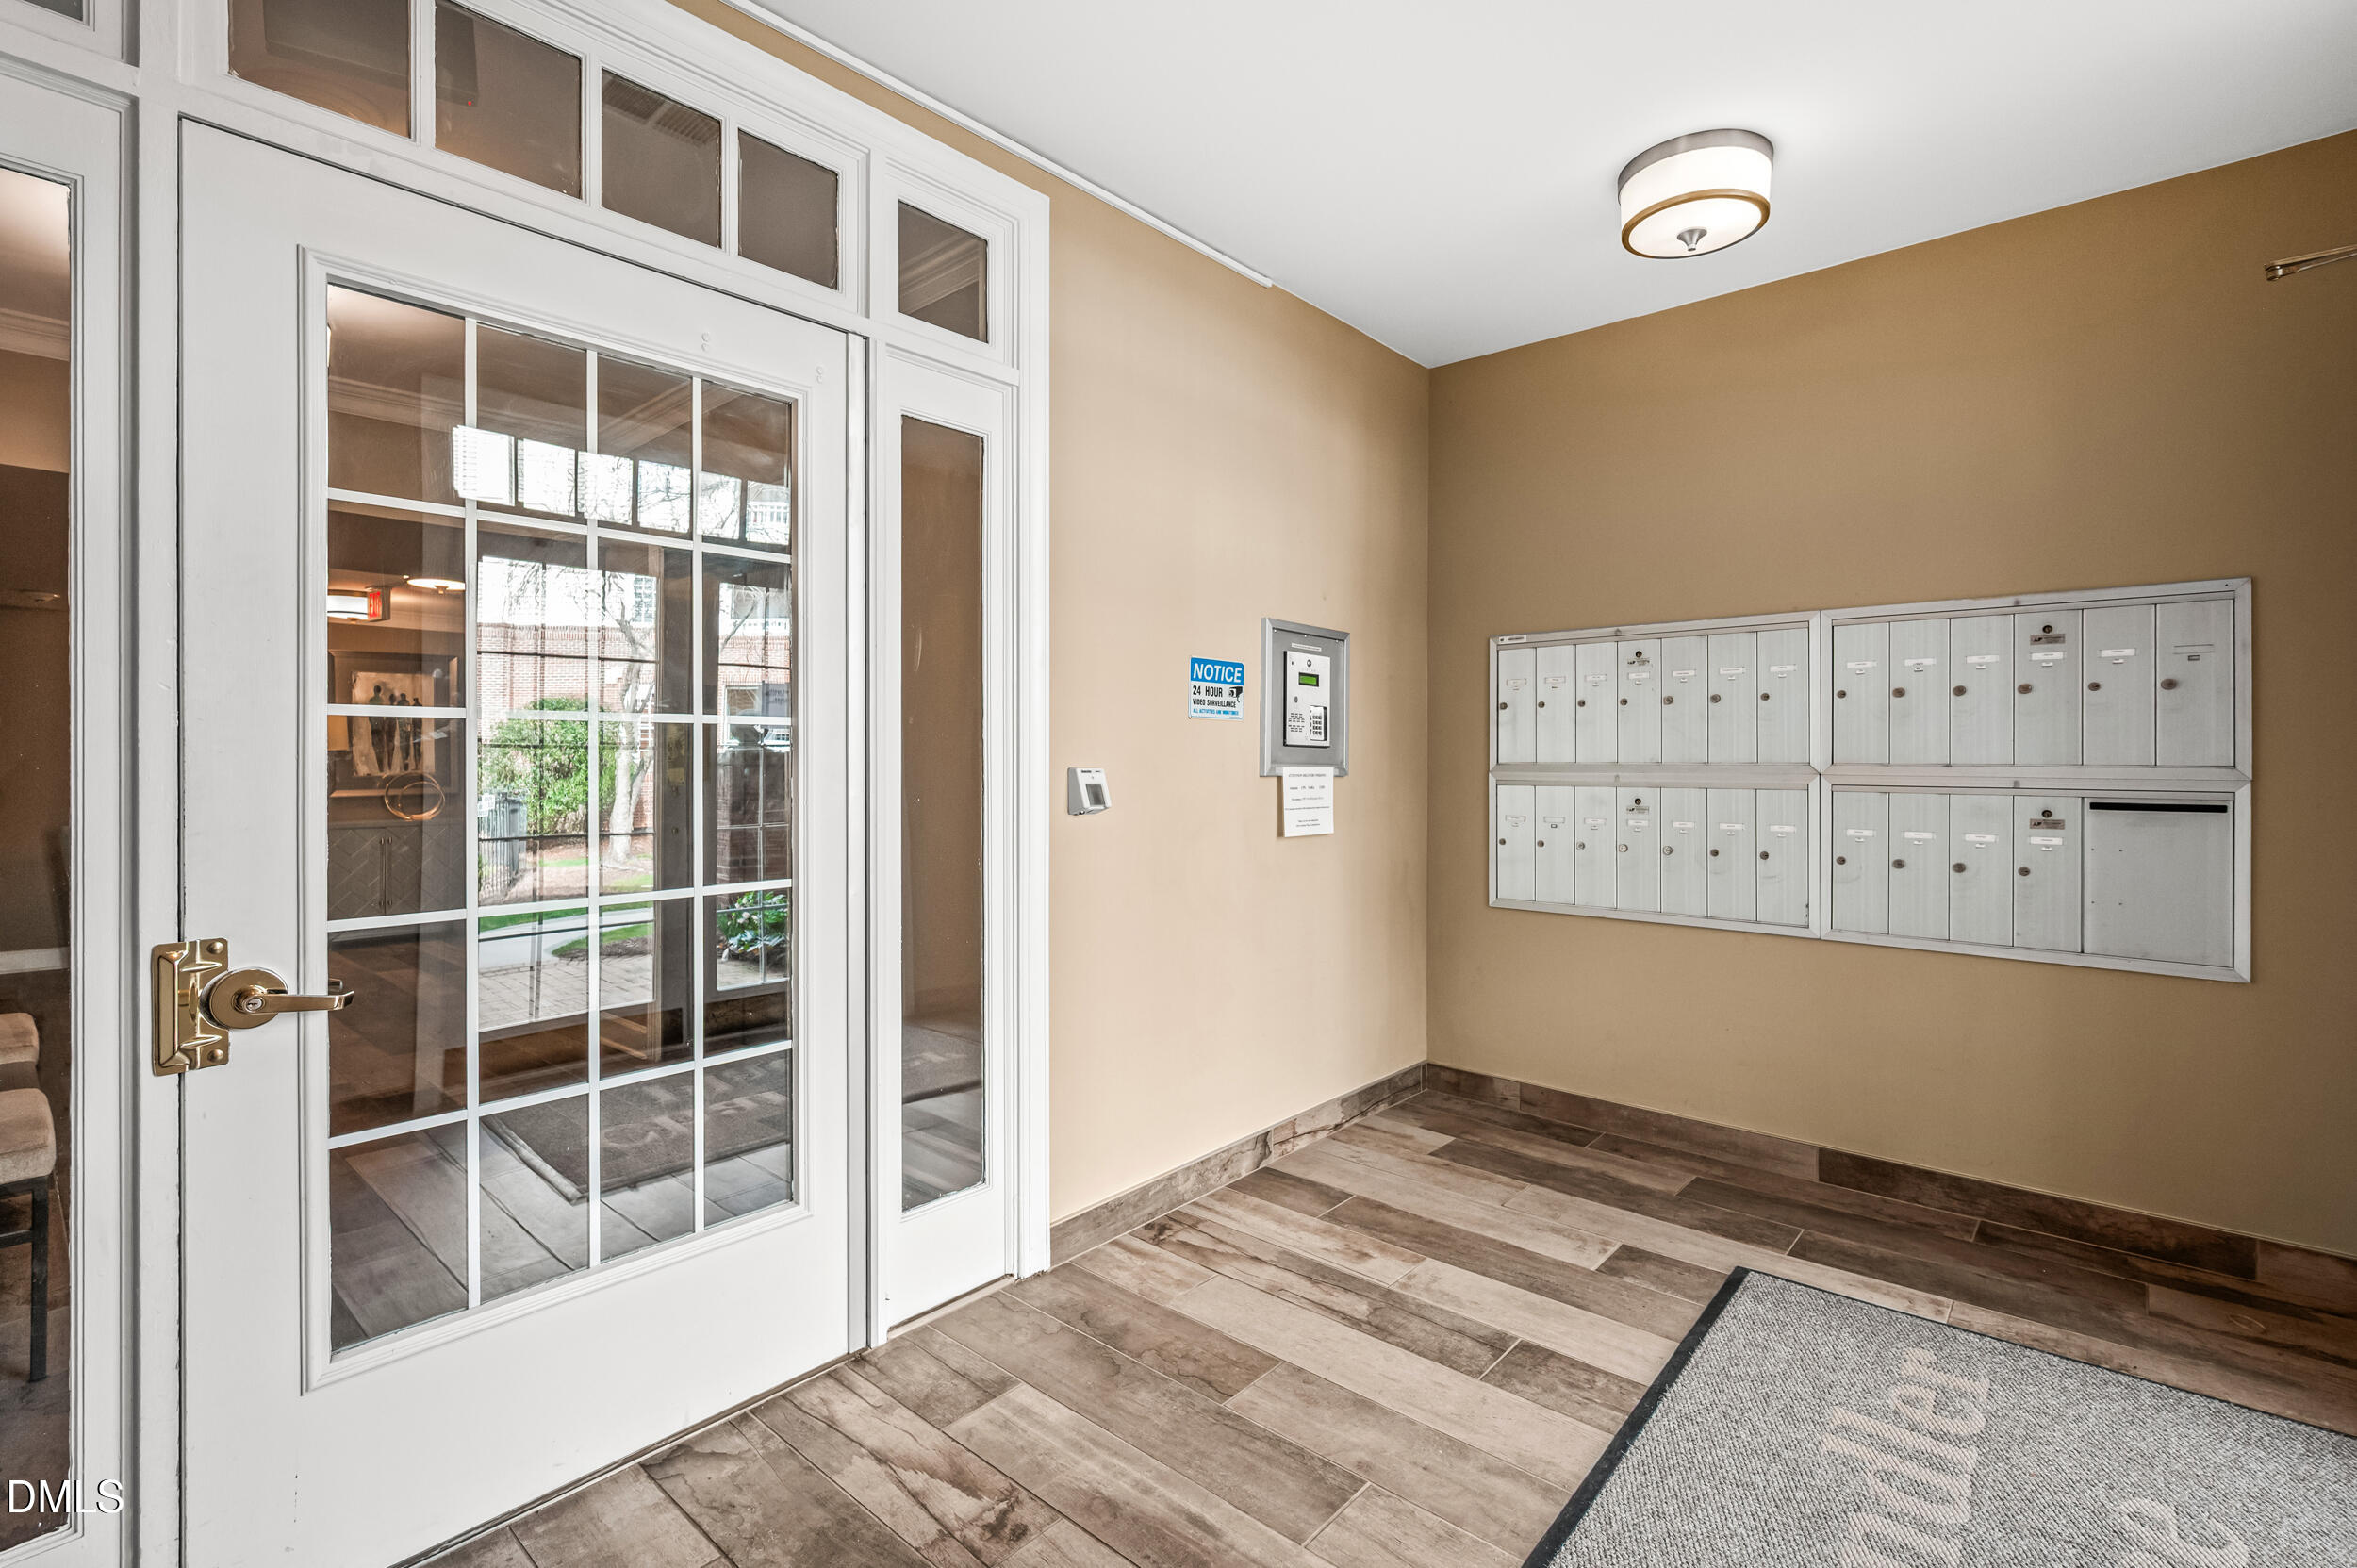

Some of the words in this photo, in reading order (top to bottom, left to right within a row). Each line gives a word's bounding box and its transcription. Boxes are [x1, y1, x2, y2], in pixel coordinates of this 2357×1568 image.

[1194, 663, 1242, 683] NOTICE
[1193, 685, 1201, 695] 24
[1205, 685, 1223, 697] HOUR
[1207, 699, 1236, 708] SURVEILLANCE
